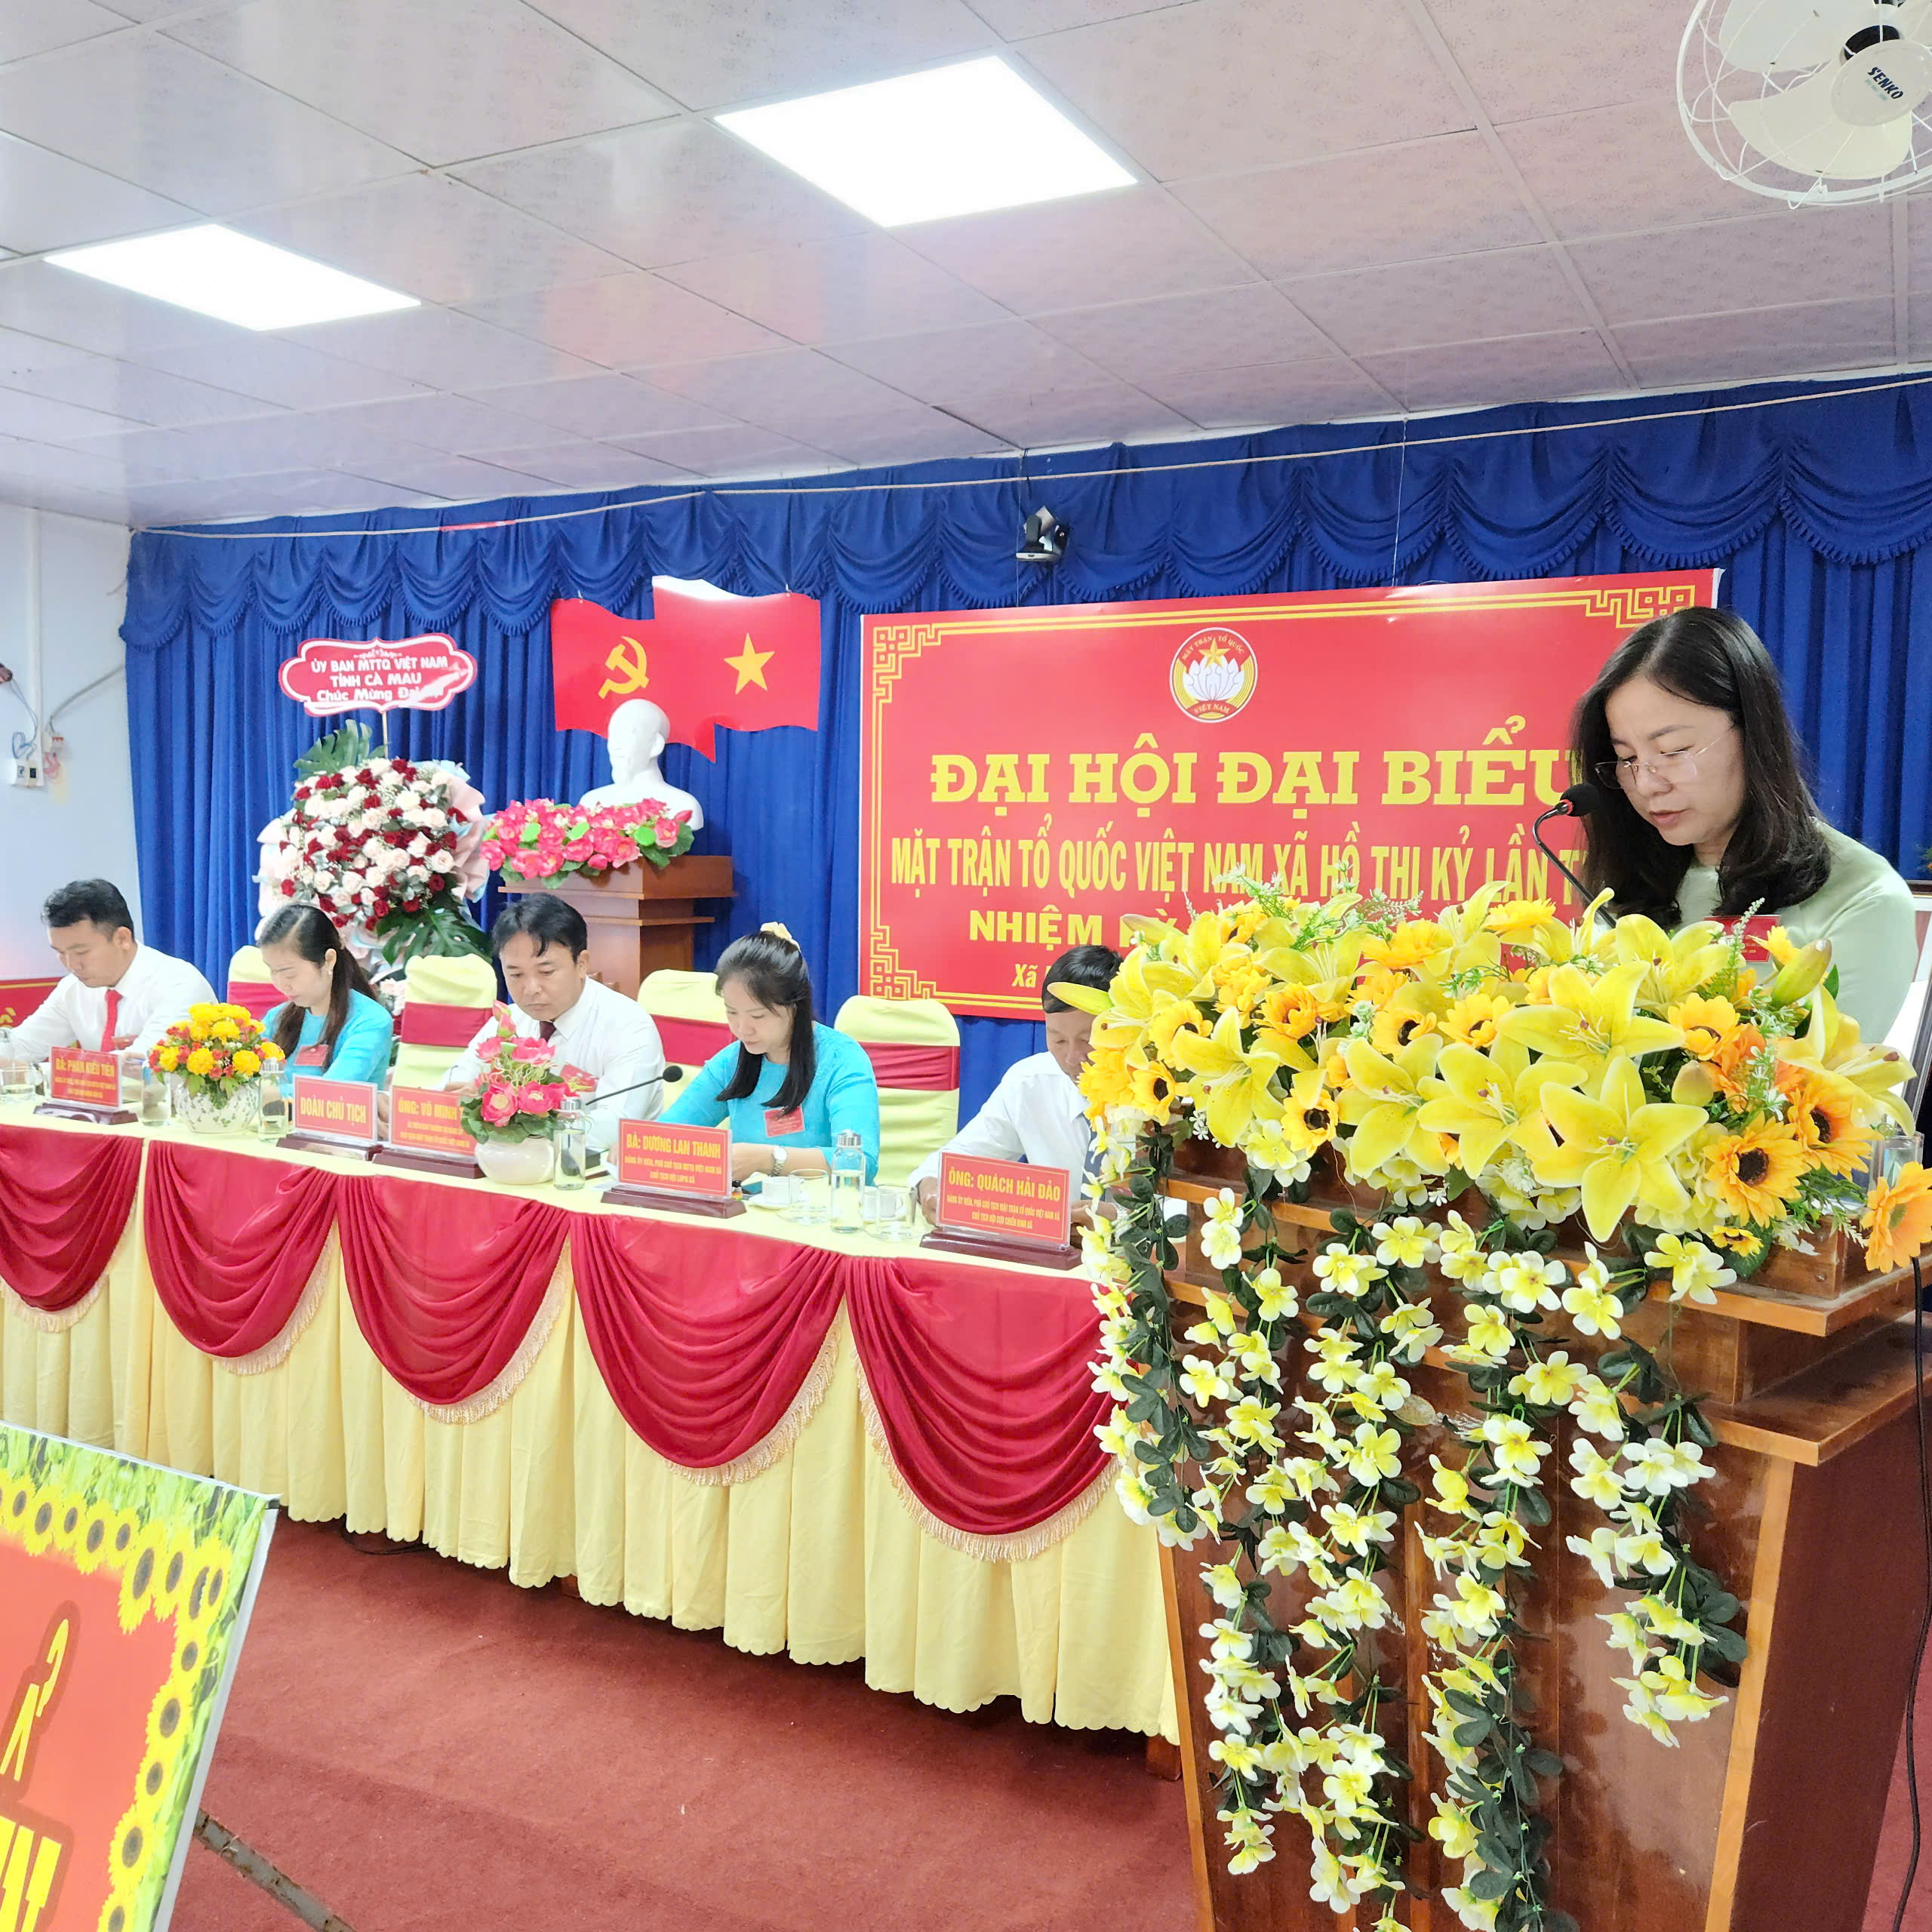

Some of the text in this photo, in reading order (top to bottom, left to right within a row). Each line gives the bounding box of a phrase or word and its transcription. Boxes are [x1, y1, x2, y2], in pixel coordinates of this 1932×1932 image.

[1867, 66, 1903, 99] SENKO
[331, 660, 355, 672] BAN
[358, 659, 391, 671] MTTQ
[394, 655, 417, 672] VIỆT
[420, 656, 448, 669] NAM
[387, 672, 422, 685] MAU
[1213, 703, 1230, 714] NAM
[931, 753, 1050, 817] ĐẠI
[1068, 733, 1197, 817] HỘI
[1217, 750, 1360, 819] ĐẠI
[891, 828, 940, 898] MẶT
[947, 825, 1011, 897] TRẬN
[1018, 813, 1052, 889] TỔ
[1058, 820, 1127, 898] QUỐC
[1135, 827, 1195, 903] VIỆT
[1203, 842, 1263, 894] NAM
[1273, 830, 1309, 897] XÃ
[1320, 821, 1361, 897] HỒ
[1431, 824, 1473, 902] KỶ
[1484, 823, 1549, 903] LẦN
[969, 904, 1103, 951] NHIỆM
[1011, 964, 1038, 988] Xã
[346, 1103, 366, 1126] TỊCH
[673, 1139, 691, 1155] LAN
[692, 1140, 721, 1159] THANH
[949, 1167, 1060, 1202] ÔNG: QUÁCH HẢI ĐẢO
